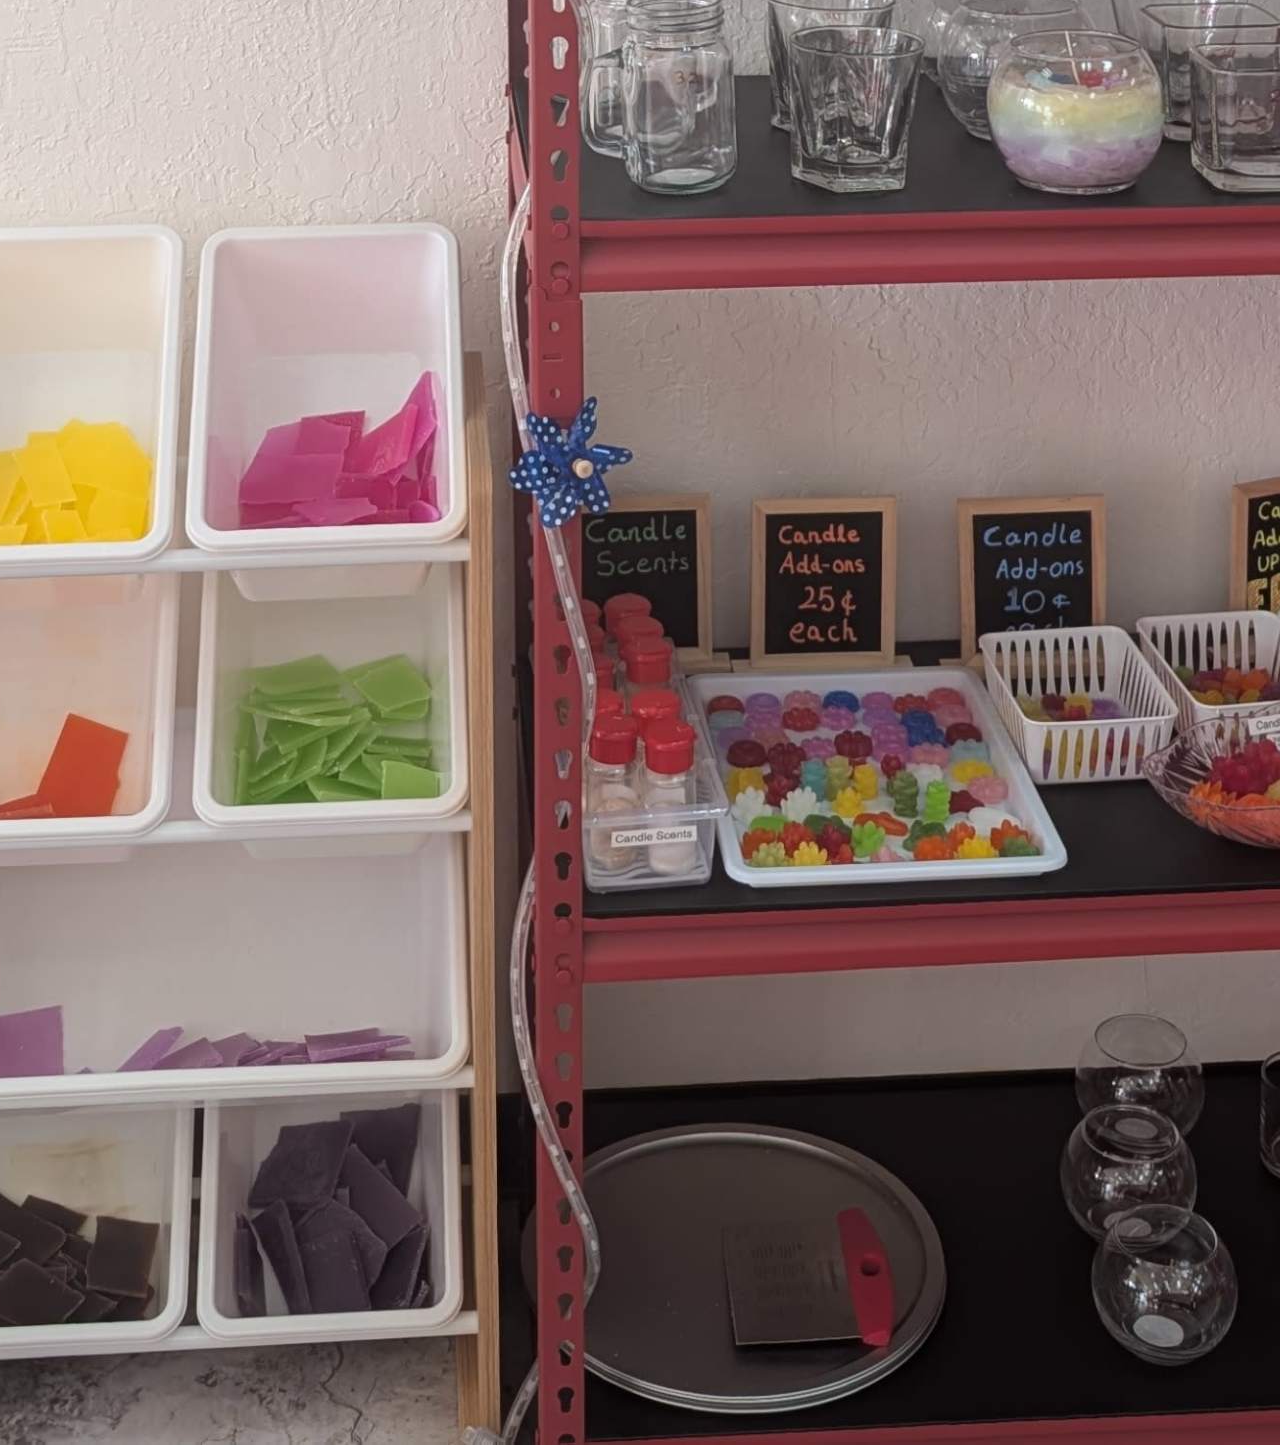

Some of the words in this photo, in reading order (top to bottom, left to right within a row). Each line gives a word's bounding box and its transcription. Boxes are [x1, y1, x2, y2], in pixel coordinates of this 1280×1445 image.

[585, 514, 688, 543] Candle
[778, 523, 861, 545] Candle
[983, 522, 1083, 547] Candle
[596, 549, 690, 576] Scents
[778, 551, 865, 574] Add-ons
[995, 557, 1085, 580] Add-ons
[788, 617, 858, 644] each
[615, 832, 653, 844] Candle
[656, 829, 693, 841] Scents
